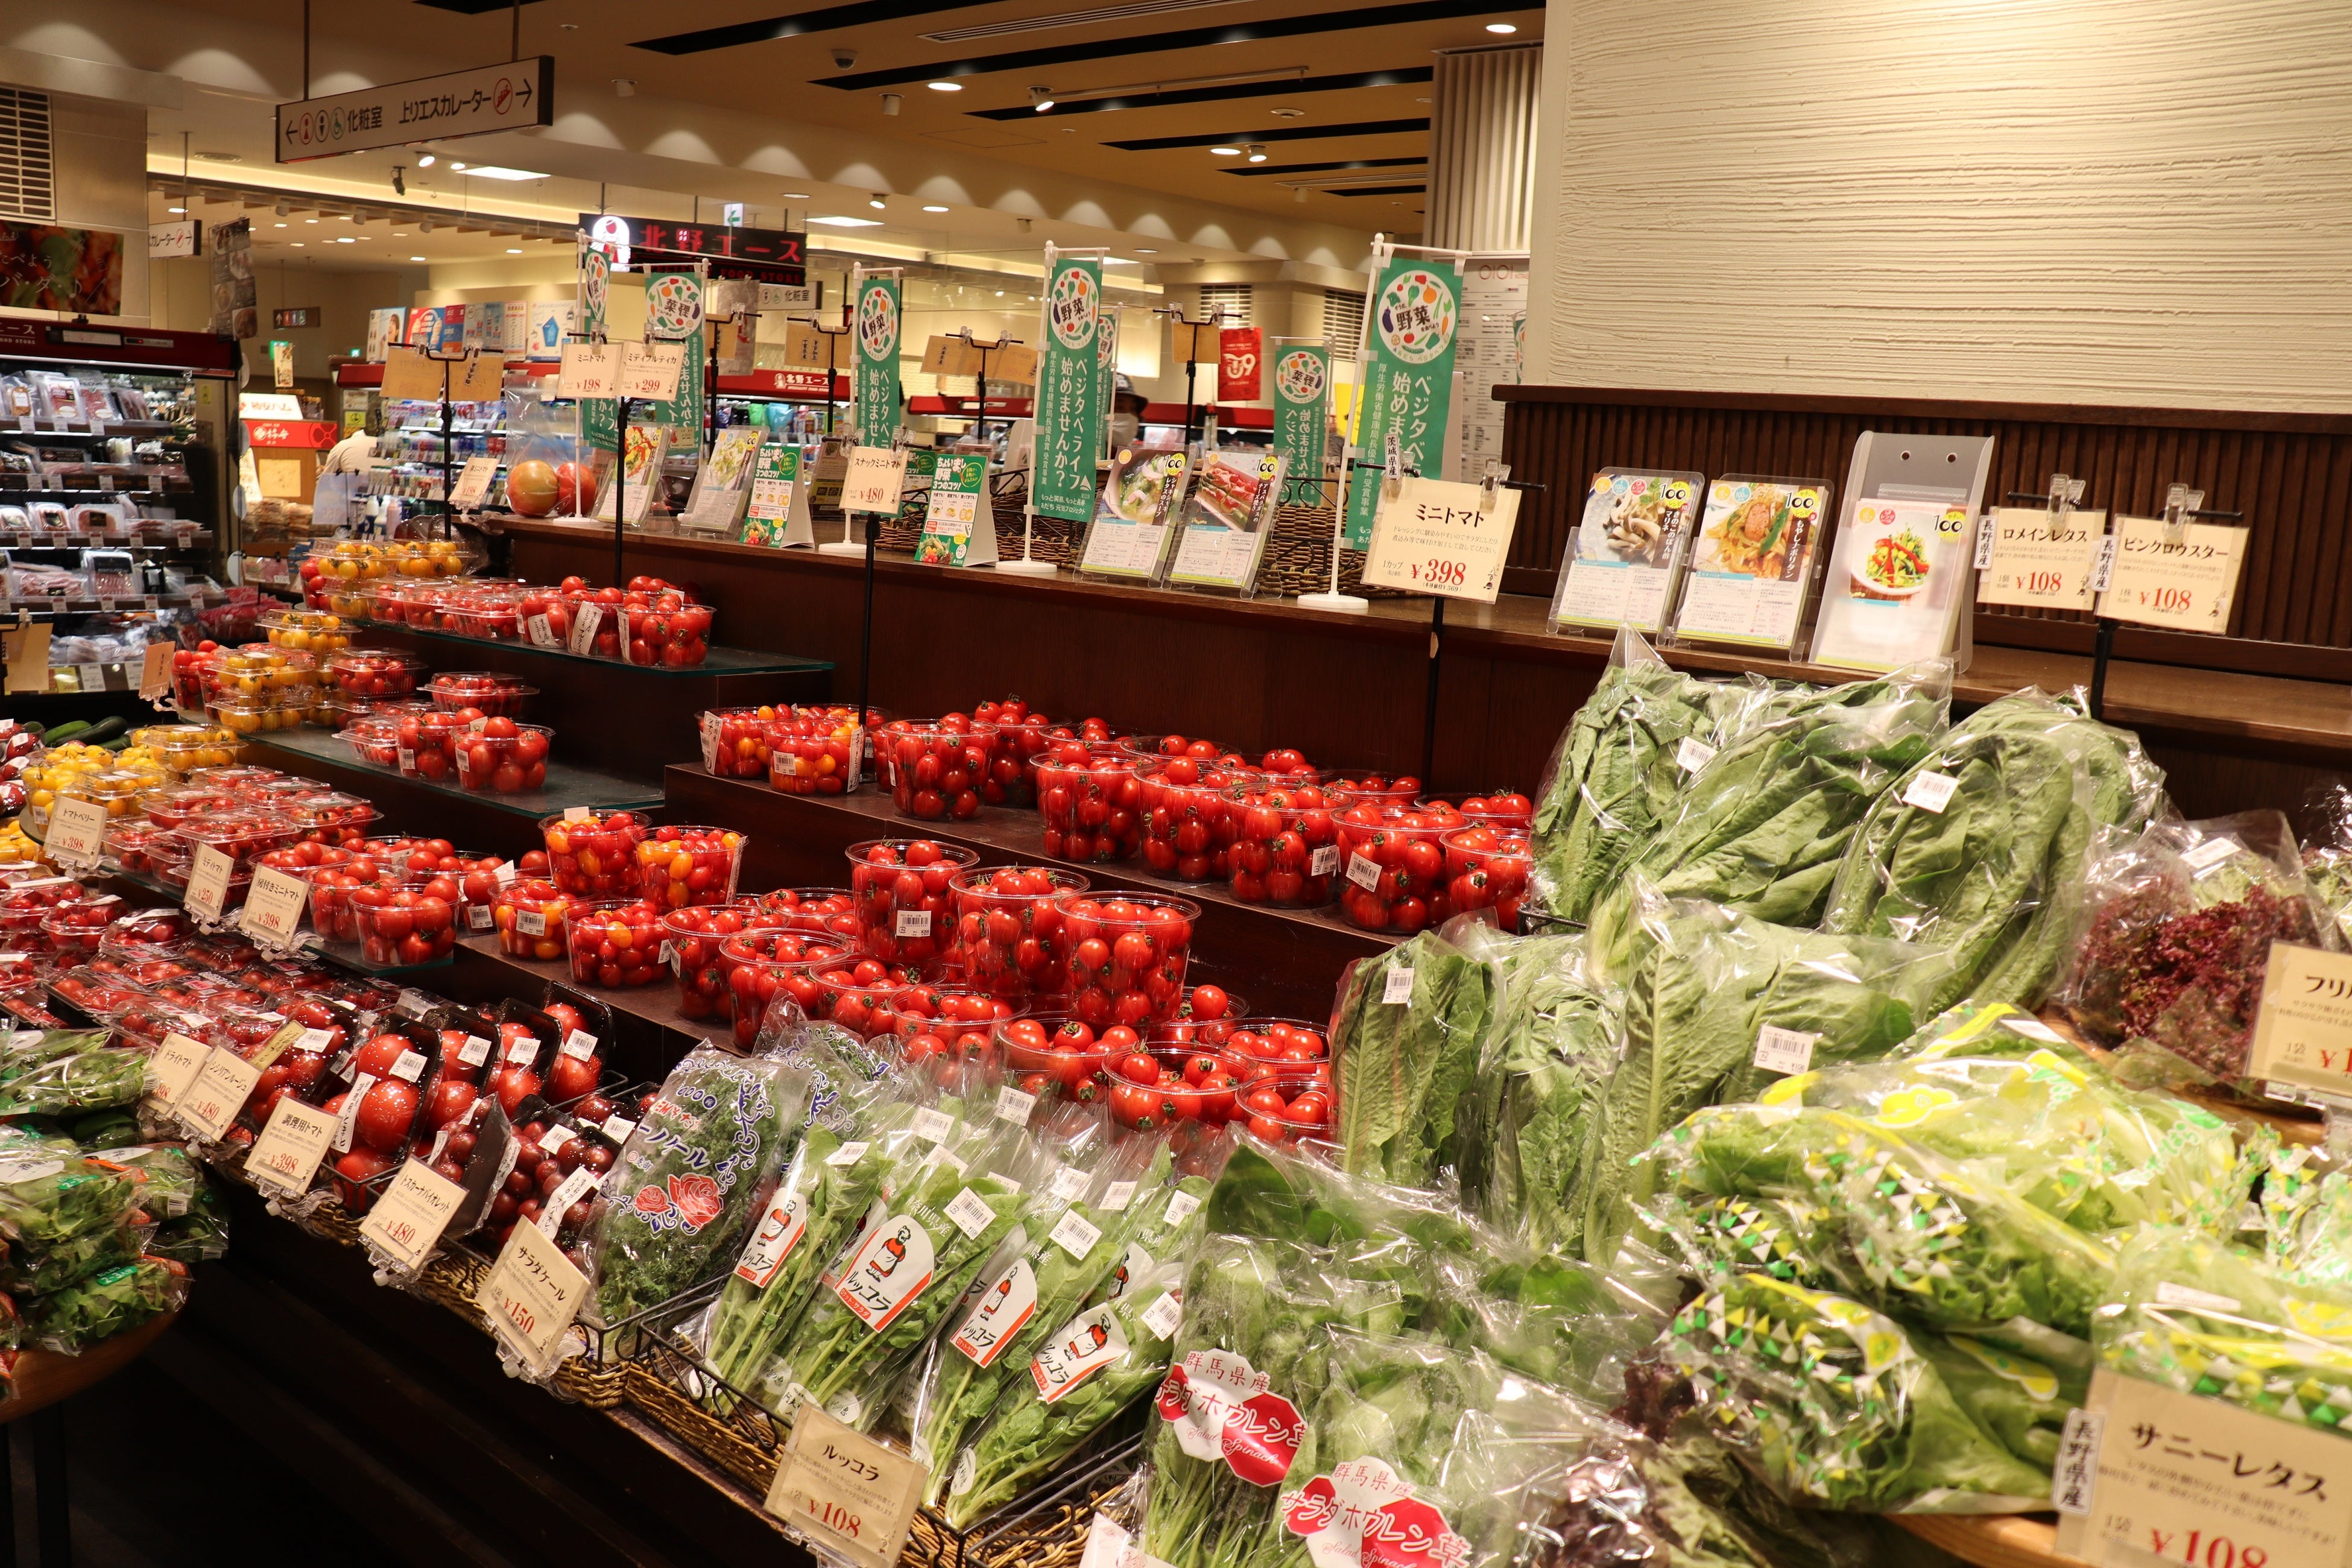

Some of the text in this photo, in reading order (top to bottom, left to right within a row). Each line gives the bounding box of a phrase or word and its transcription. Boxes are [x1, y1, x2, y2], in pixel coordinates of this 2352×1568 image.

[347, 89, 492, 133] 化粧室 上りエスカレーター
[639, 224, 801, 262] 北野エース
[760, 272, 801, 283] STORE
[785, 289, 810, 302] 化粧室
[1061, 297, 1085, 322] 野菜
[1396, 305, 1430, 332] 野菜
[868, 314, 885, 337] 野菜
[577, 354, 606, 362] ミニトマト
[577, 379, 601, 391] ¥198
[635, 379, 660, 391] ¥299
[1054, 357, 1073, 487] 始めませんか?
[1069, 359, 1087, 490] ベジタベライフ
[855, 457, 901, 469] スナックミニトマト
[1164, 454, 1183, 469] 100
[1256, 459, 1275, 473] 100
[1387, 436, 1398, 476] 茨城県産
[859, 487, 884, 501] ¥480
[1155, 477, 1171, 517] レタスのスープ
[1253, 482, 1268, 523] アスパラガスの
[1359, 478, 1373, 517] 受賞事業
[1660, 483, 1686, 500] 100
[1786, 492, 1814, 508] 100
[1415, 504, 1484, 528] ミニトマト
[1662, 511, 1672, 531] マリネ
[1933, 514, 1963, 533] 100
[1978, 519, 1994, 566] 長野県産
[2003, 528, 2088, 543] ロメインレタス
[1785, 520, 1804, 578] もやしナポリタン
[2123, 537, 2229, 560] ピンクロウスター
[1411, 558, 1466, 586] ¥398
[2096, 540, 2113, 588] 長野県産
[2017, 571, 2063, 592] ¥108
[2139, 587, 2192, 611] ¥108
[63, 808, 95, 822] トマトベリー
[62, 836, 85, 851] ¥398
[203, 856, 223, 874] ミディトマト
[198, 888, 213, 905] ¥250
[257, 877, 300, 901] 房付きミニトマト
[258, 912, 281, 930] ¥398
[2306, 975, 2352, 999] フリ
[165, 1049, 192, 1069] ドライトマト
[209, 1060, 248, 1092] シシリアンルージュ
[197, 1099, 221, 1121] ¥480
[281, 1113, 323, 1137] 調理用トマト
[270, 1152, 299, 1174] ¥398
[400, 1174, 450, 1213] トスカーナバイオレット
[386, 1220, 416, 1245] ¥480
[741, 1247, 776, 1271] ルッコラ
[517, 1245, 566, 1301] サラダケール
[845, 1270, 892, 1312] ルッコラ
[503, 1297, 535, 1335] ¥150
[839, 1288, 871, 1320] ロケット・サラダ
[1184, 1350, 1271, 1394] 群馬県産
[823, 1444, 879, 1481] ルッコラ
[1222, 1438, 1279, 1465] Spinach
[2129, 1421, 2328, 1503] サニーレタス
[2060, 1421, 2094, 1509] 長野県産
[1332, 1463, 1417, 1499] 群馬県産
[808, 1498, 861, 1538] ¥108
[1281, 1490, 1473, 1568] サラダホウレン草
[2150, 1528, 2268, 1568] ¥108
